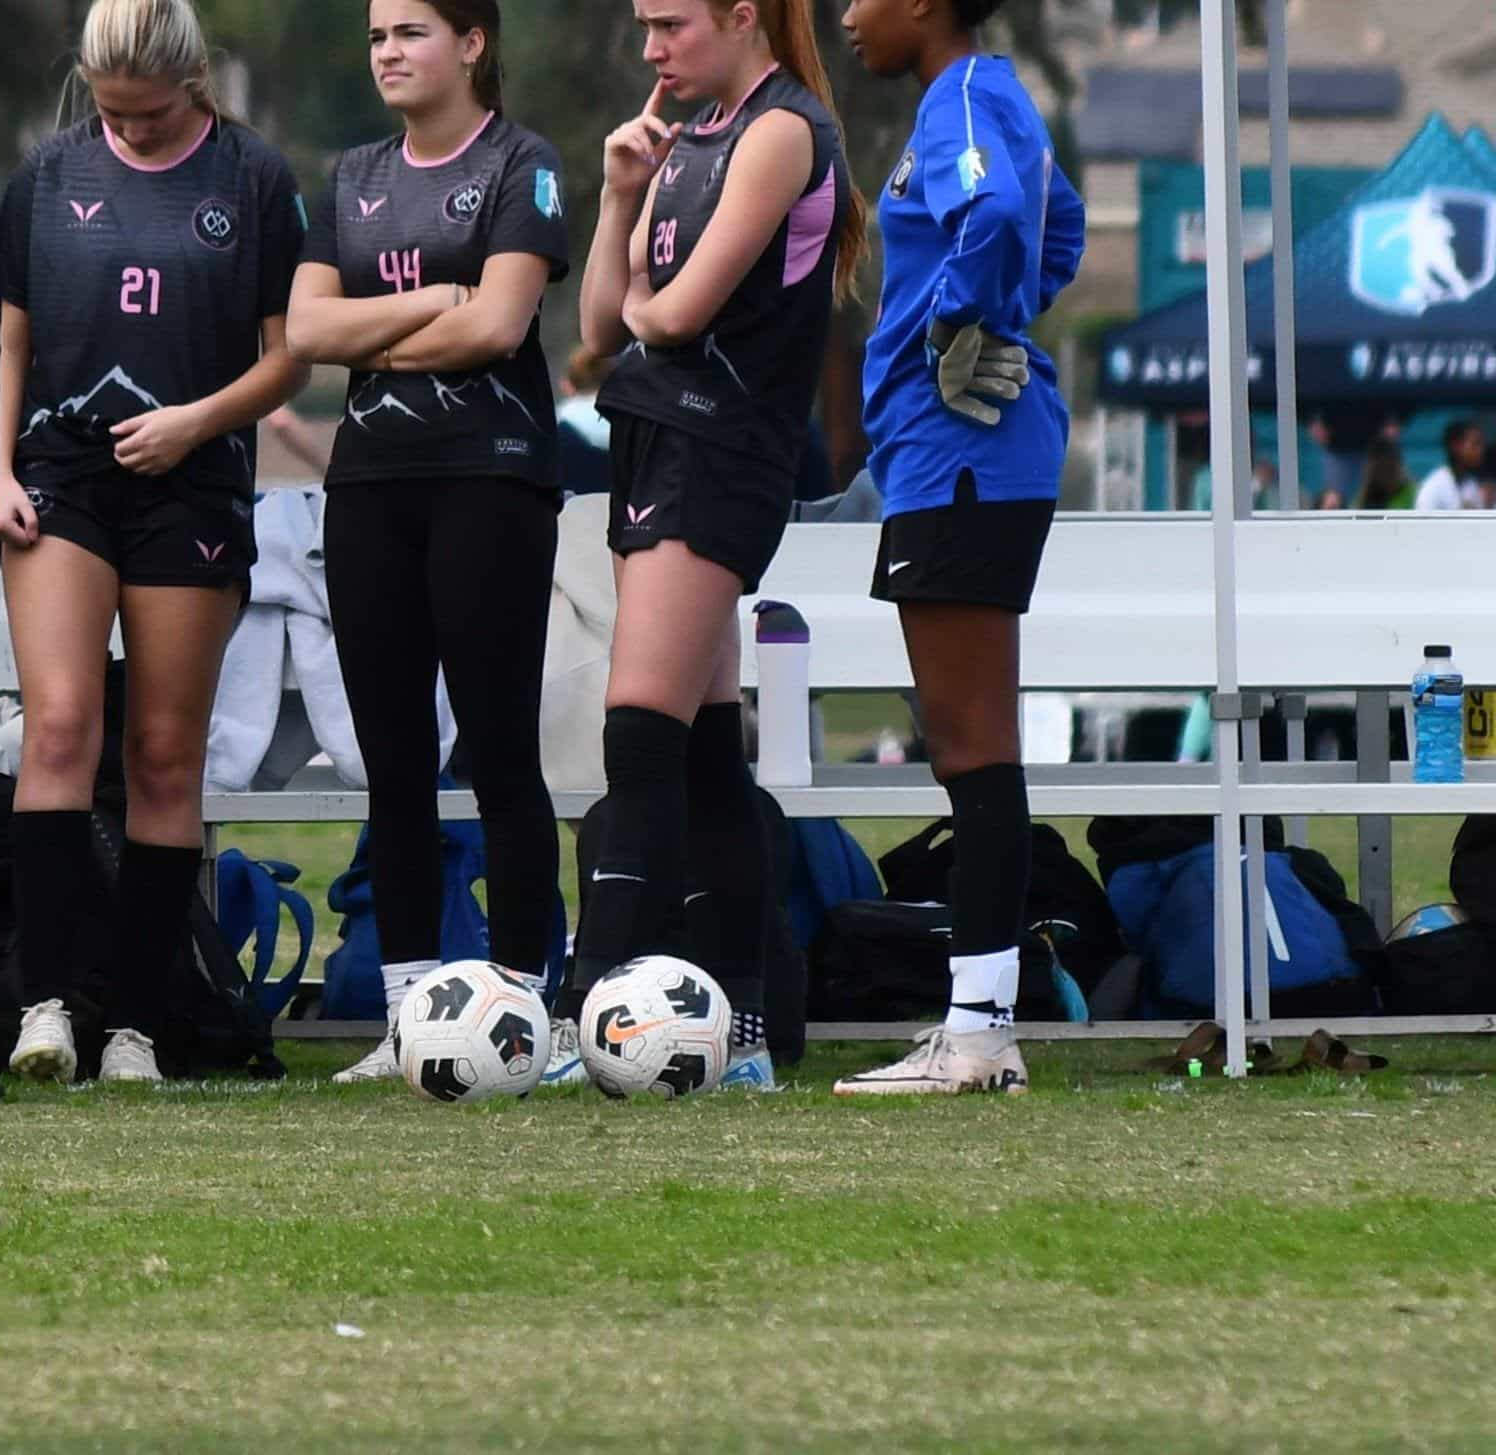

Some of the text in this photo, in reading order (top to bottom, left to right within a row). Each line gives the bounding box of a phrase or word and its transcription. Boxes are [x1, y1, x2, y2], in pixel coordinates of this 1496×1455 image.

[654, 219, 677, 265] 28
[120, 267, 160, 315] 21
[379, 248, 422, 294] 44
